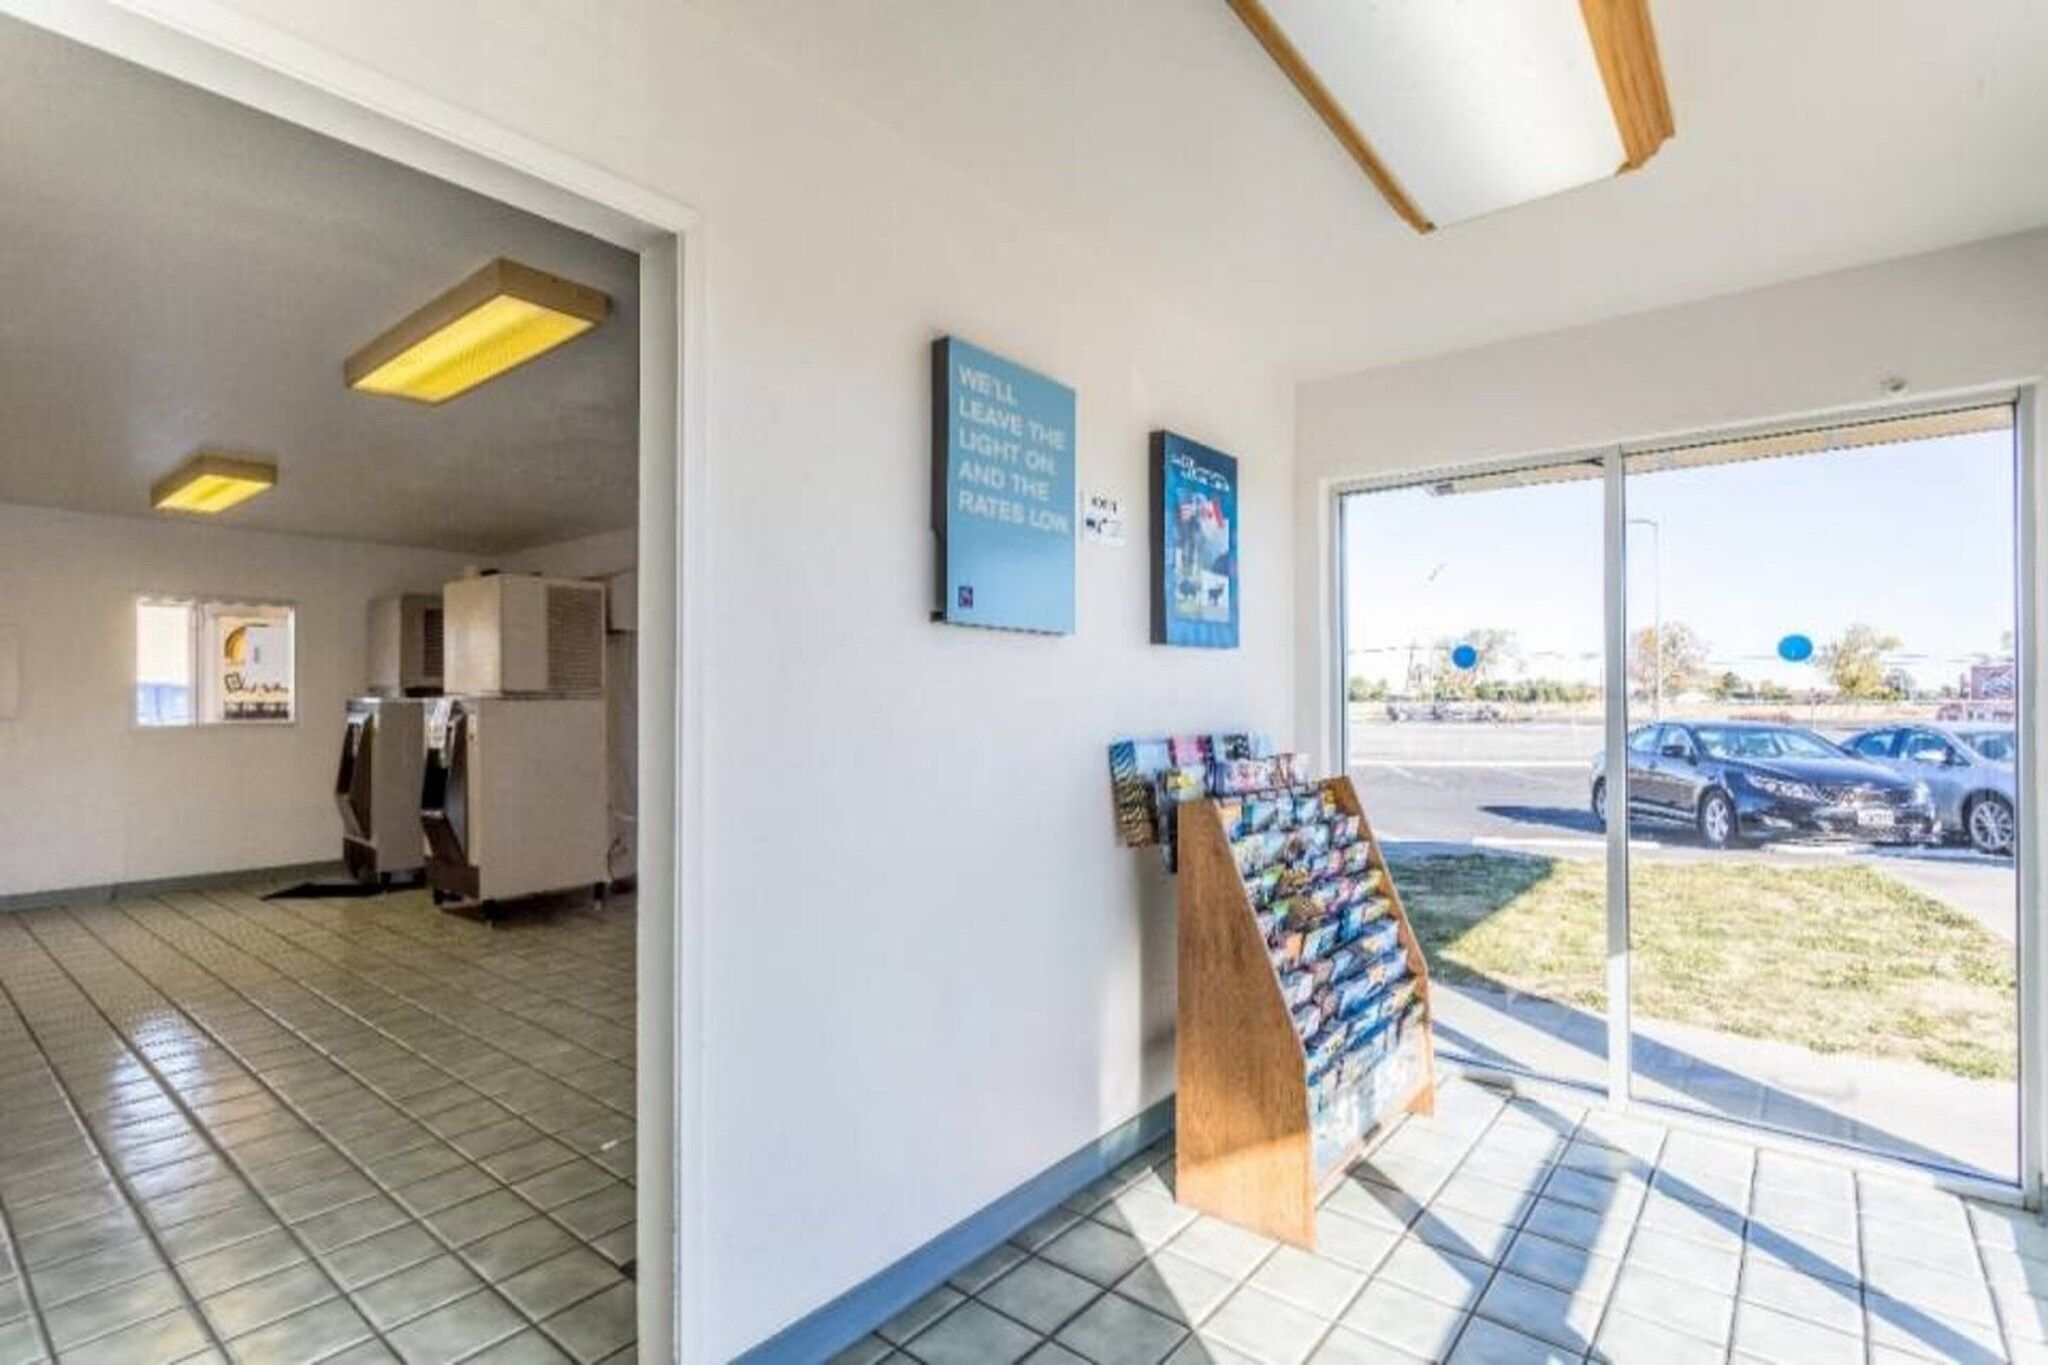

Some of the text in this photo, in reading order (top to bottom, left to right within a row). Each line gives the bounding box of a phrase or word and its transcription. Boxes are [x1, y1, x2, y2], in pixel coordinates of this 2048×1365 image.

[959, 364, 1018, 406] WE'LL
[959, 396, 1065, 451] LEAVE THE
[960, 426, 1020, 465] LIGHT
[958, 460, 1050, 502] AND THE
[958, 489, 1024, 525] RATES
